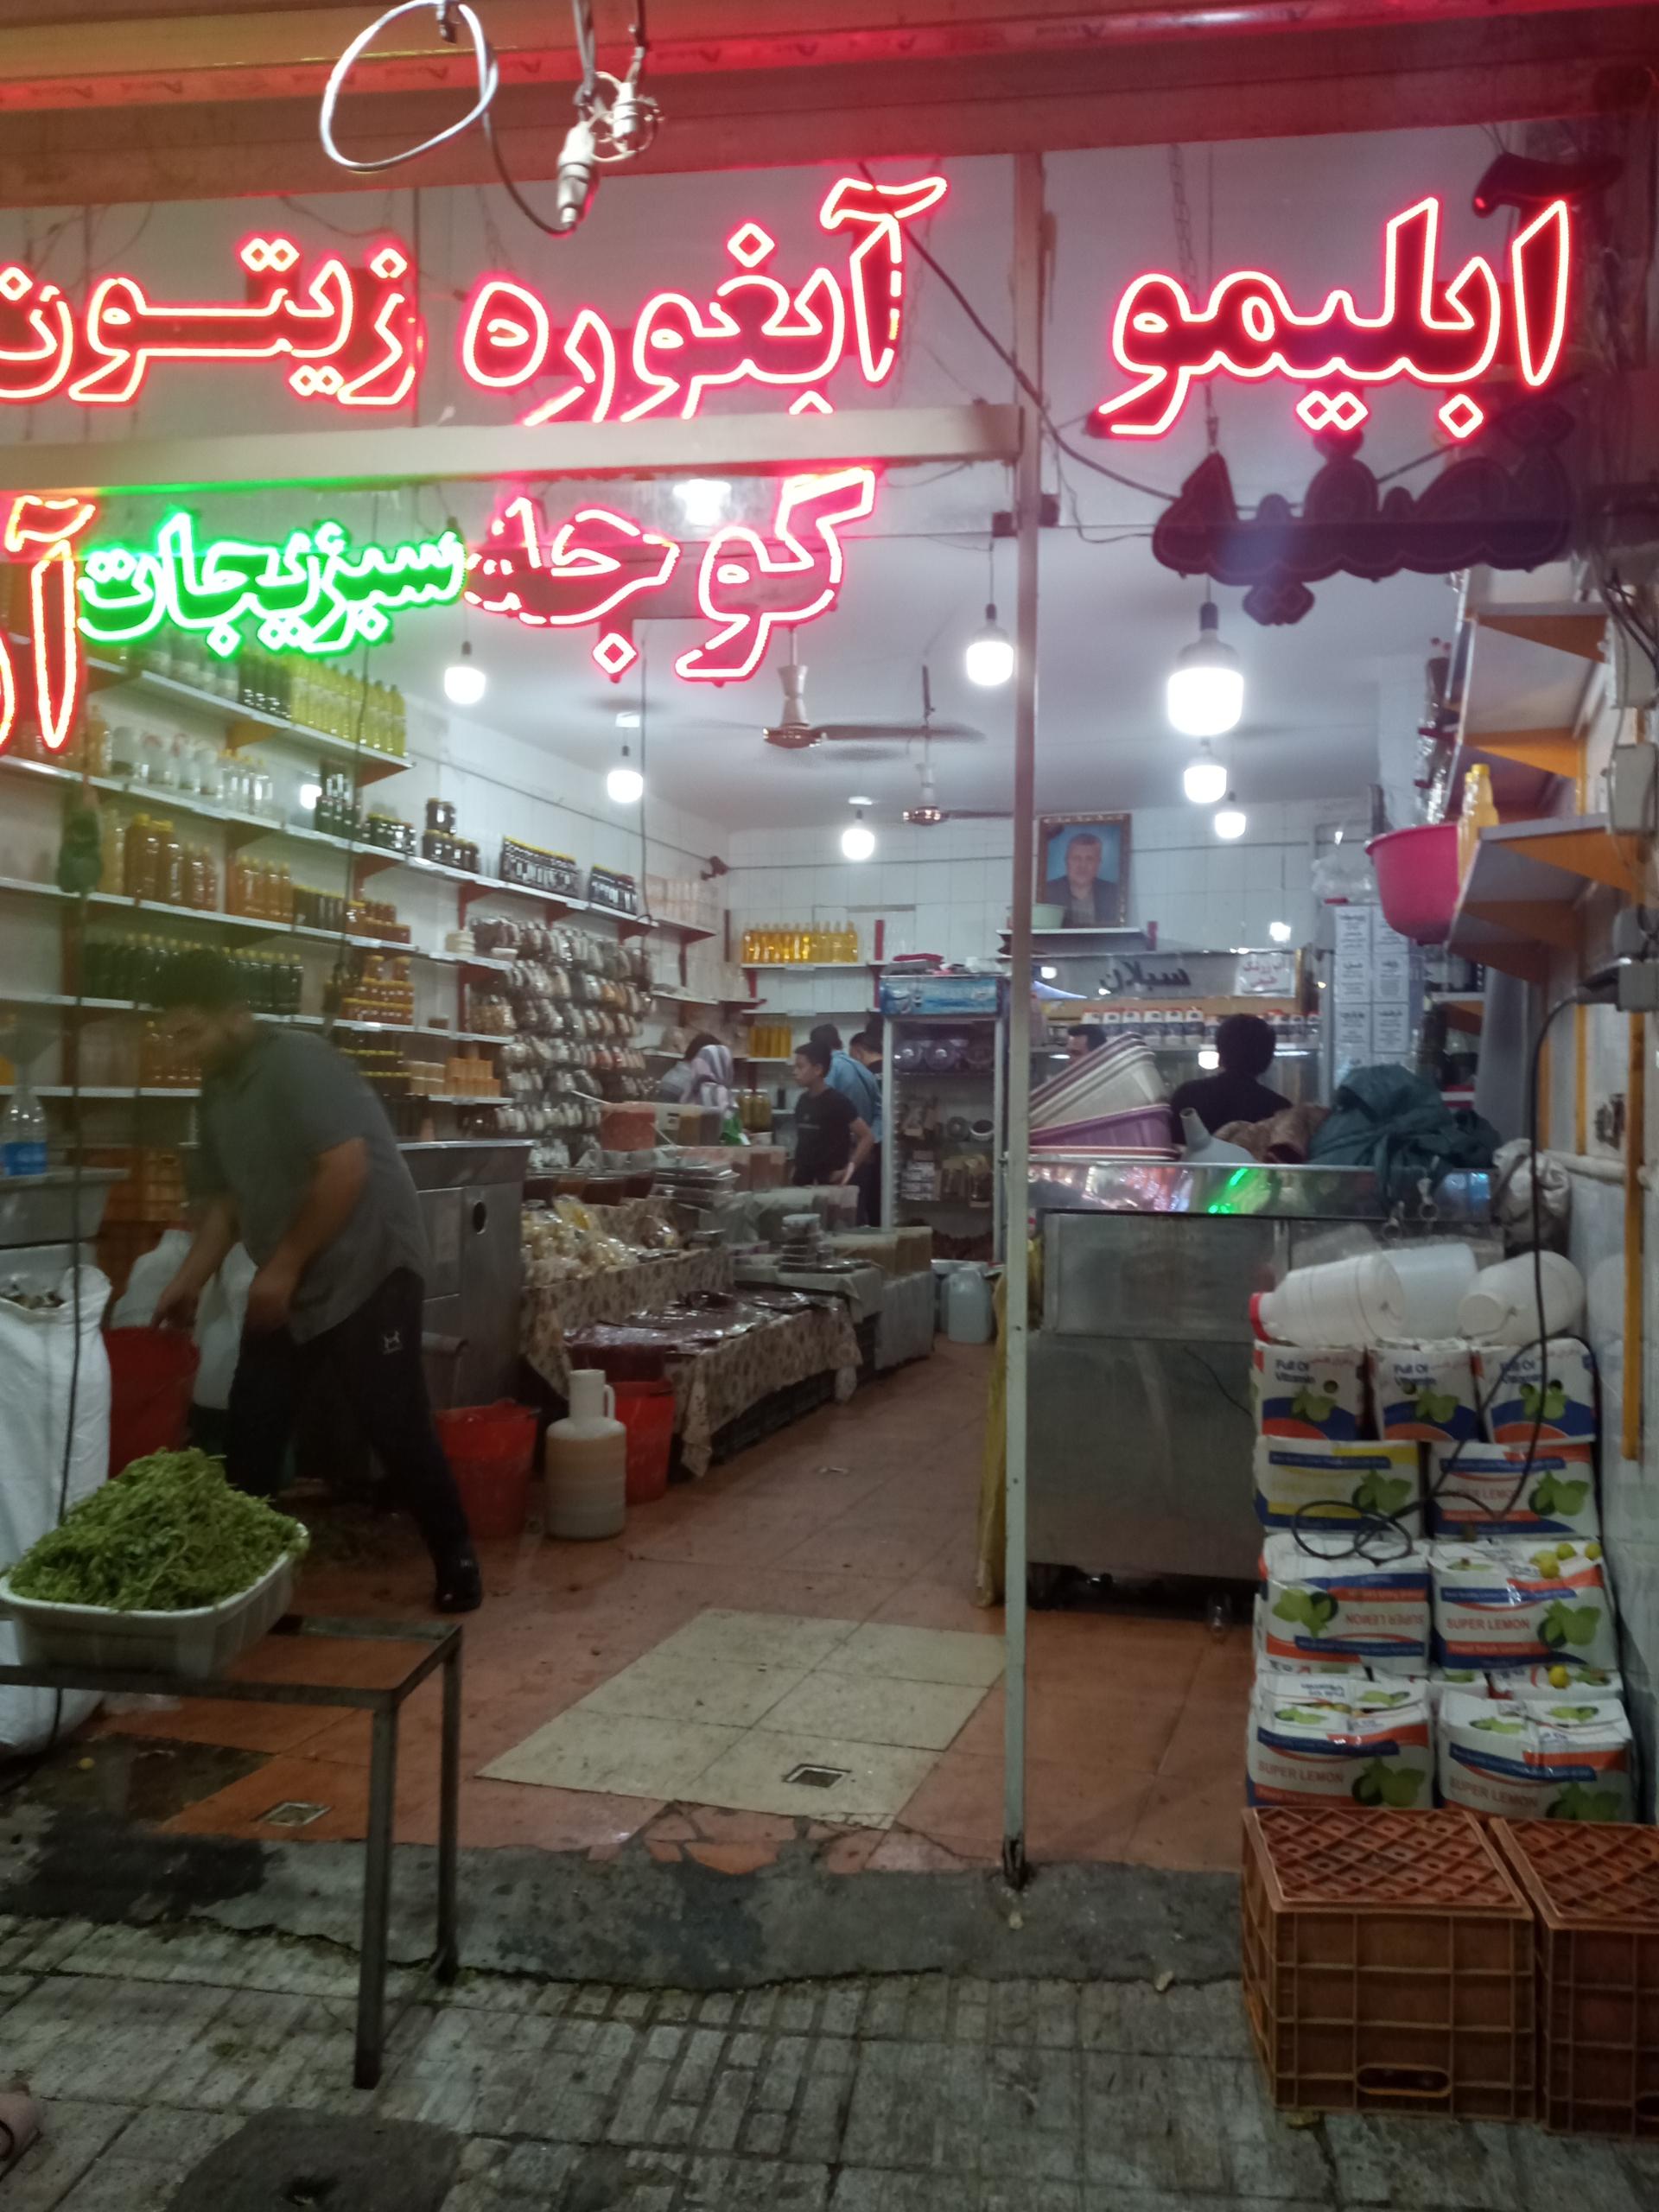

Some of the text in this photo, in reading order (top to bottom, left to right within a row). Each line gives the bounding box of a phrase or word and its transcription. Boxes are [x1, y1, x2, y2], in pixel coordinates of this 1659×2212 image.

[0, 235, 418, 406] زیتون
[461, 175, 949, 425] آبغوره
[76, 508, 468, 658] سبزیجات
[1446, 1618, 1530, 1630] SUPER LEMON
[1258, 1760, 1344, 1784] SUPER LEMON
[1449, 1776, 1539, 1808] SUPER LEMON
